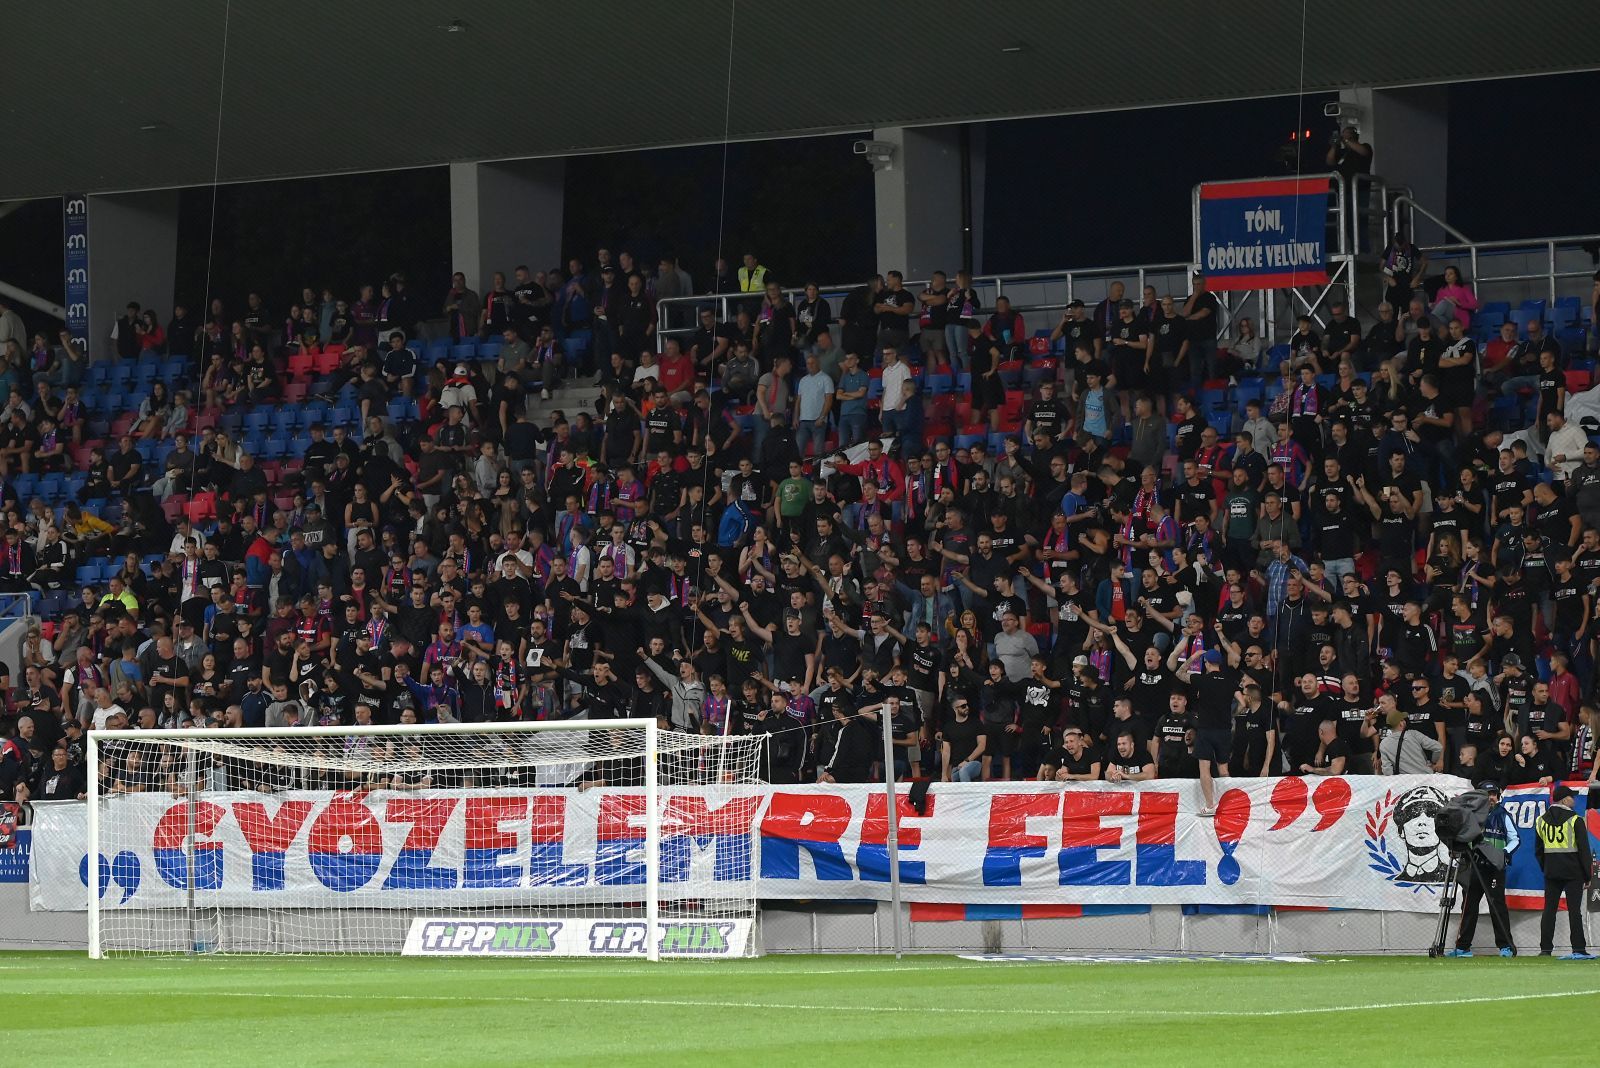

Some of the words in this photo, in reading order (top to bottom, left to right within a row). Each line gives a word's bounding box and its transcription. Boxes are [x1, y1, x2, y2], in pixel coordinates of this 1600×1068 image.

[1244, 204, 1284, 235] TÓNI,
[1207, 240, 1263, 270] ÖRÖKKÉ
[1265, 239, 1321, 268] VELÜNK!
